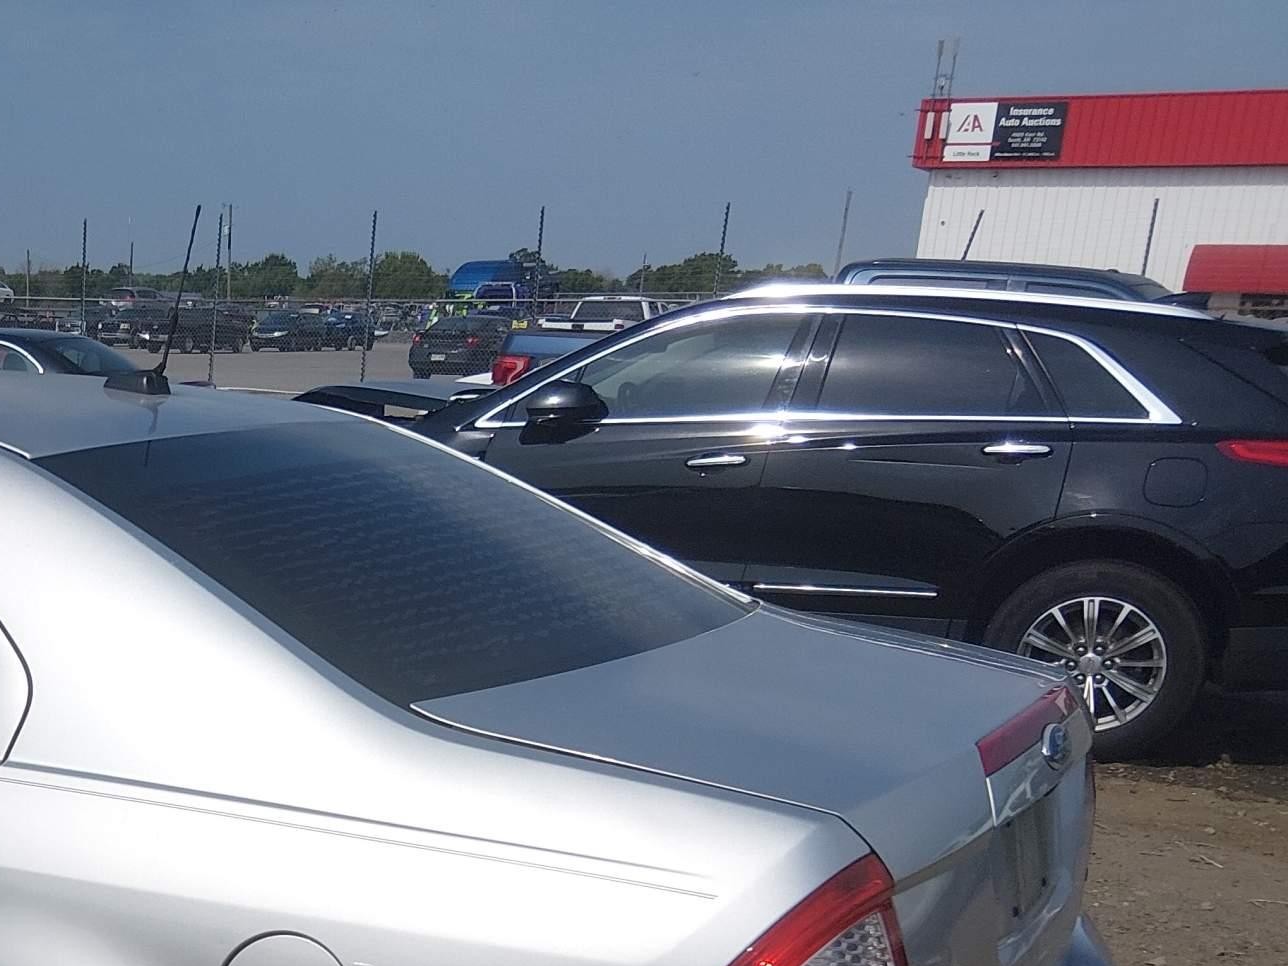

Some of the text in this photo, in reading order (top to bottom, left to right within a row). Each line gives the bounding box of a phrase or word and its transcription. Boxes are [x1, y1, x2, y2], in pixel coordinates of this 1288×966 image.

[1009, 106, 1055, 116] Insurance
[999, 117, 1062, 127] Auto Auctions
